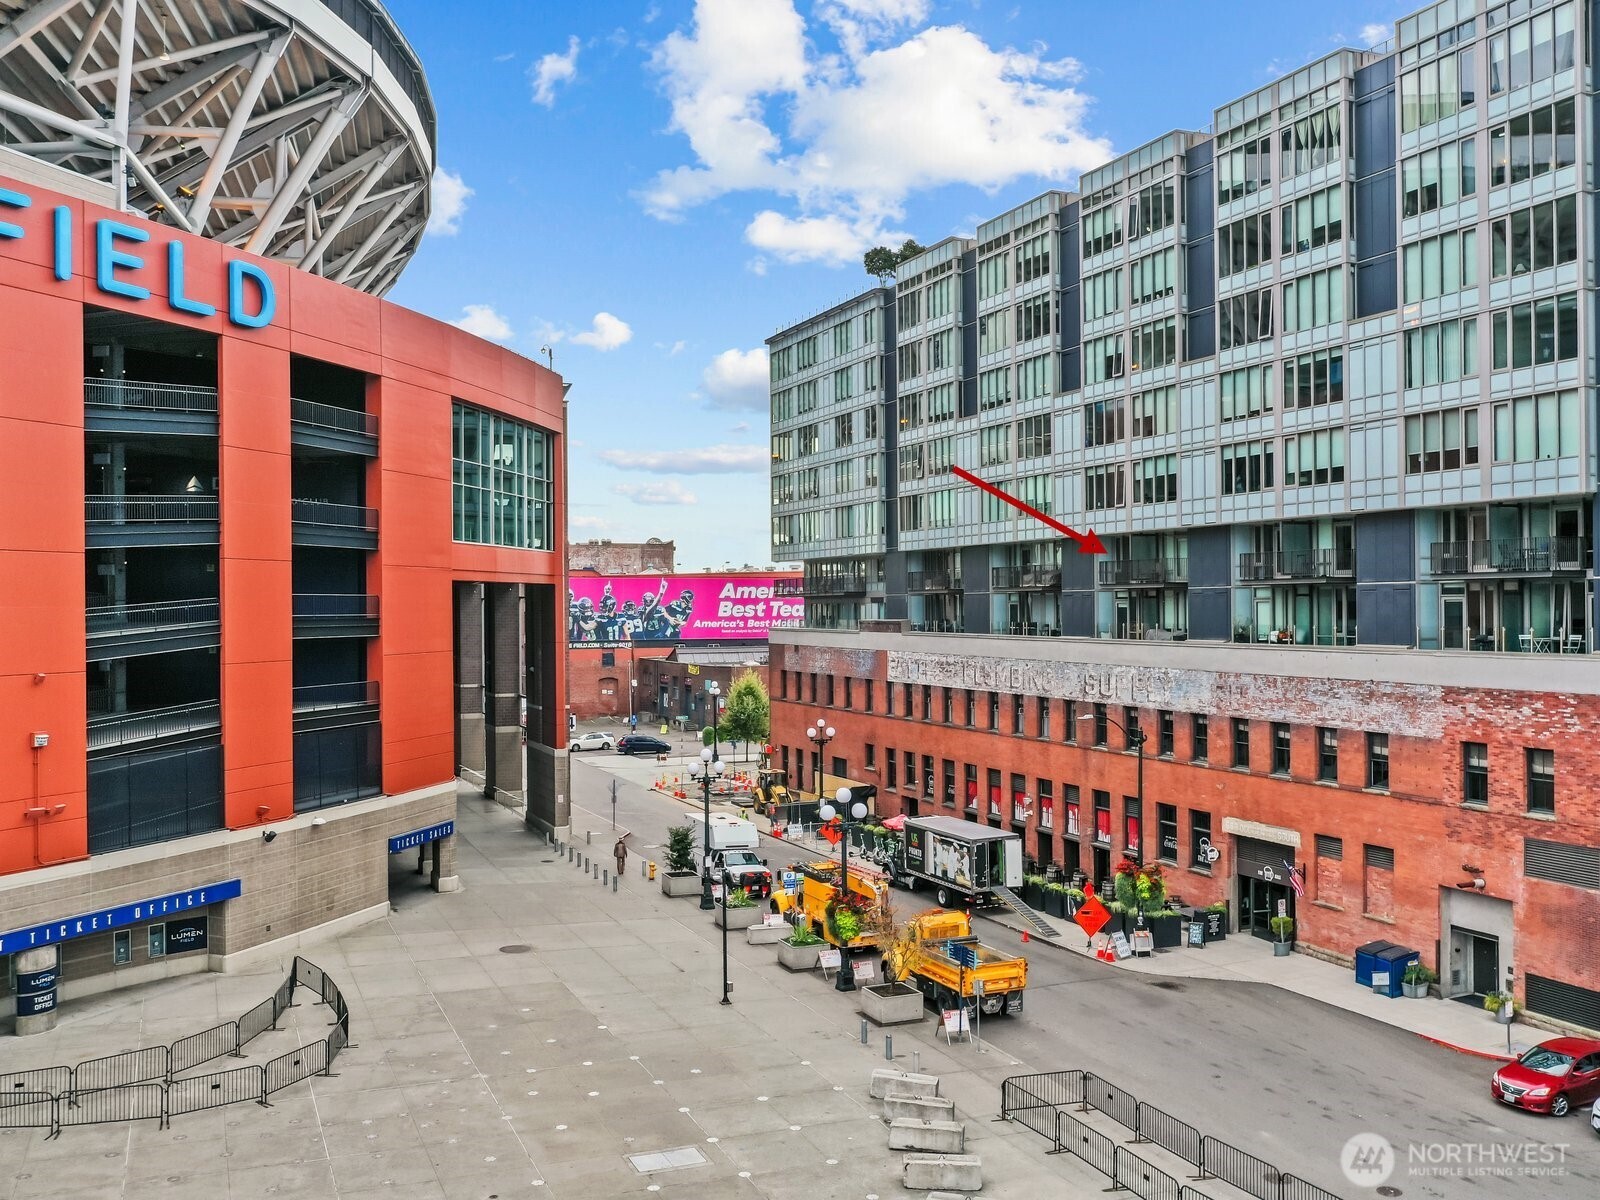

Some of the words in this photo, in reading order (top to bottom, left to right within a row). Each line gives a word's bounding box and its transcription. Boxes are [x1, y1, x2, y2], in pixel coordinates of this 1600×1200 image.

[718, 601, 766, 617] Best
[693, 619, 744, 628] America's
[747, 619, 770, 628] Best
[607, 626, 619, 640] 11
[397, 833, 424, 849] TICKET
[429, 825, 451, 839] SALES
[30, 914, 113, 944] TICKET
[135, 892, 206, 918] OFFICE
[170, 929, 204, 941] LUMEN
[31, 975, 56, 986] LUMEN
[34, 993, 53, 1004] TICKET
[34, 1000, 53, 1011] OFFICE
